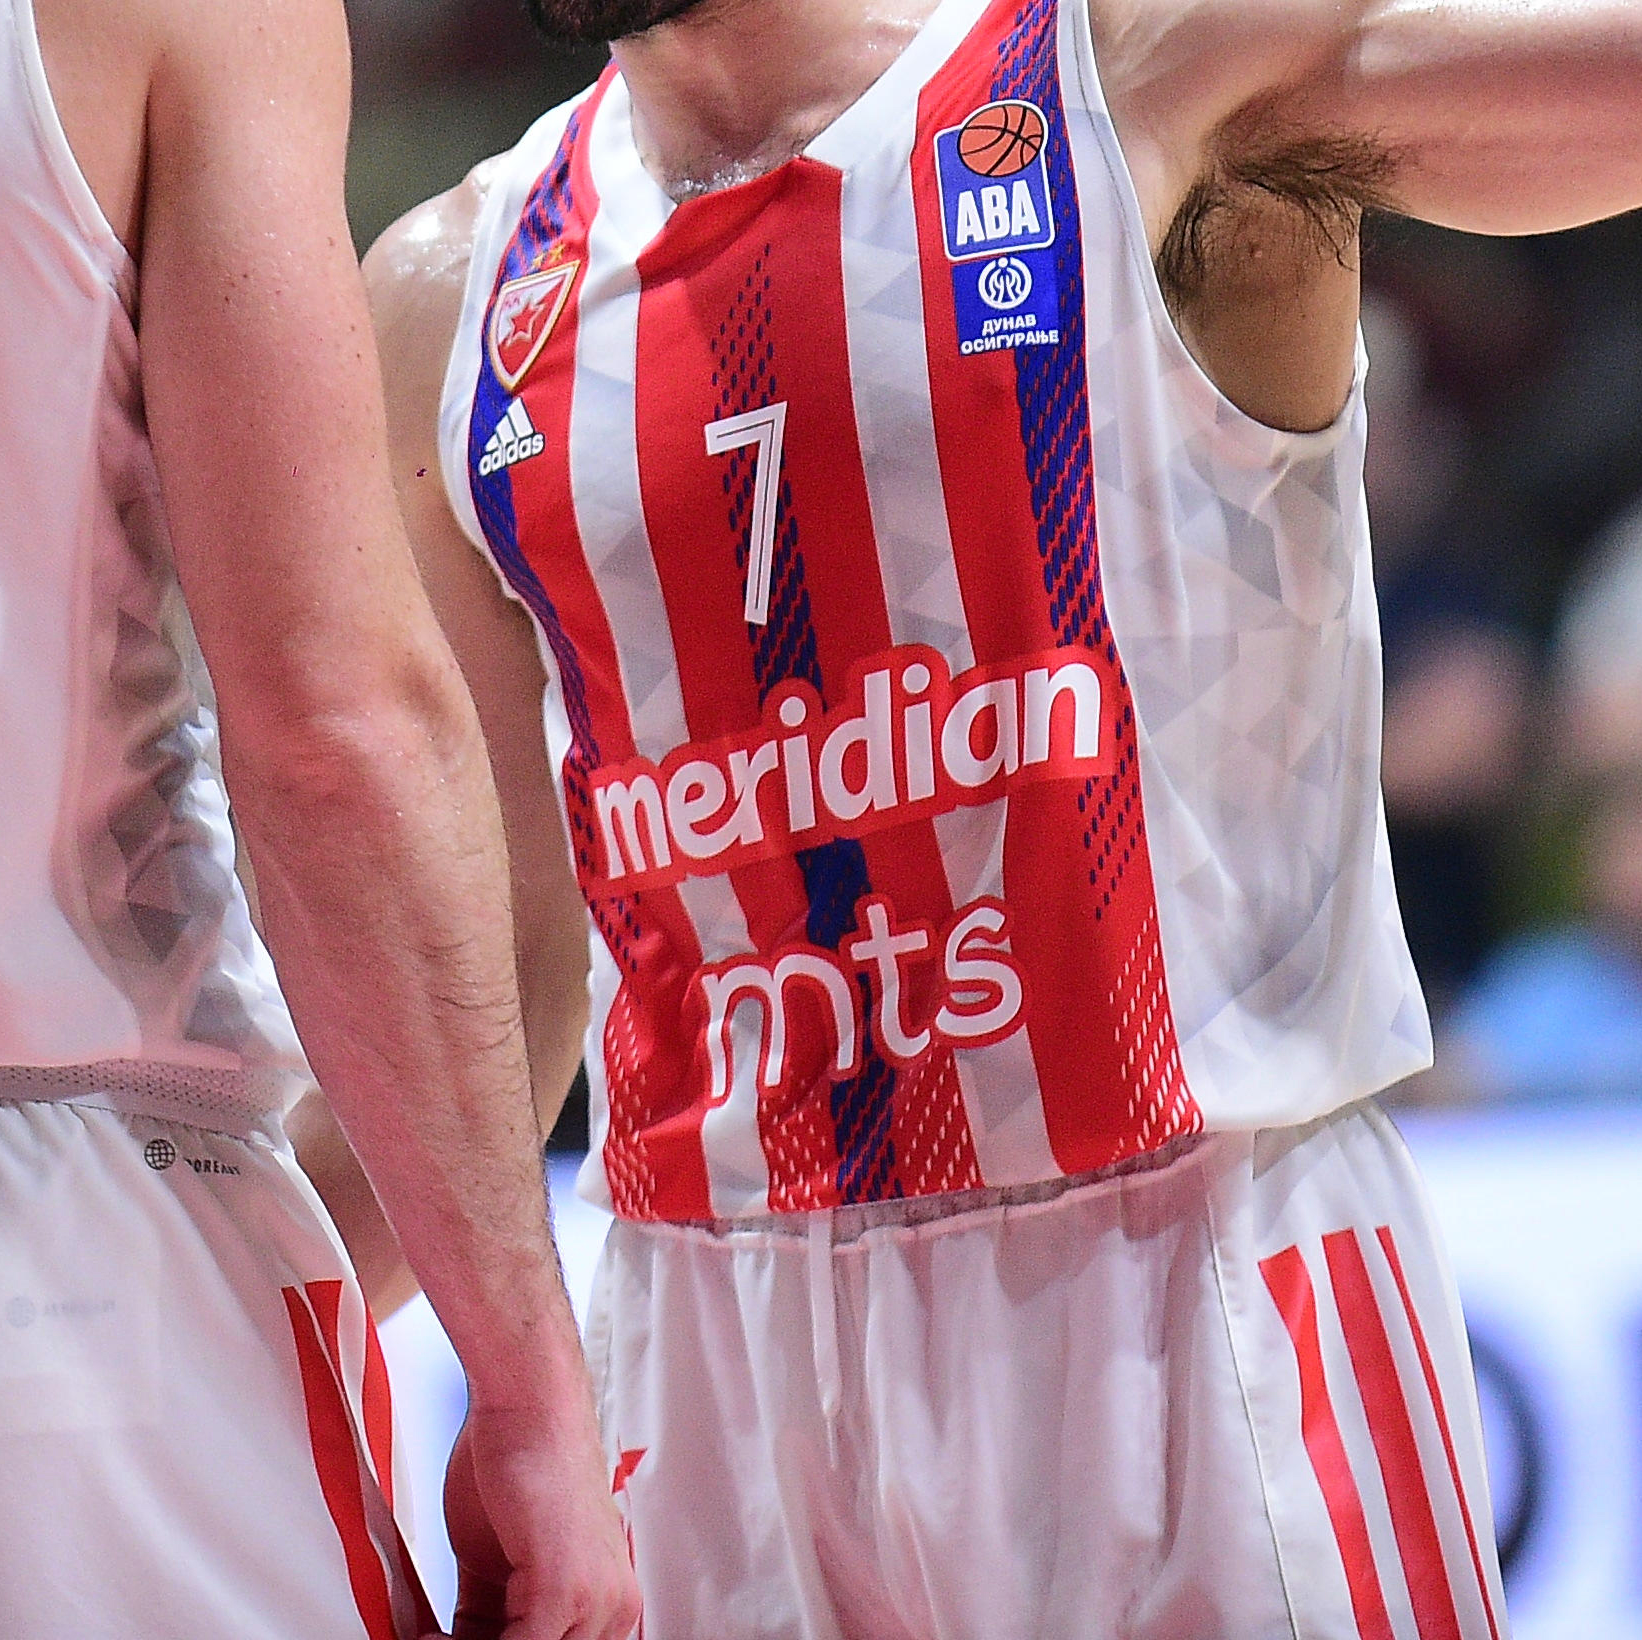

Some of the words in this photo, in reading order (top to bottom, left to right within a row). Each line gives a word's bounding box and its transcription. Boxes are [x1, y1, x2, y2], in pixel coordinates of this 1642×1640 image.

[956, 179, 1041, 246] ABA
[960, 330, 1060, 355] ОСИГУРАЊЕ
[981, 314, 1037, 337] ДУНАВ
[478, 432, 545, 477] adidas
[705, 401, 787, 626] 7
[593, 661, 1102, 881] meridian
[703, 903, 1023, 1099] mts
